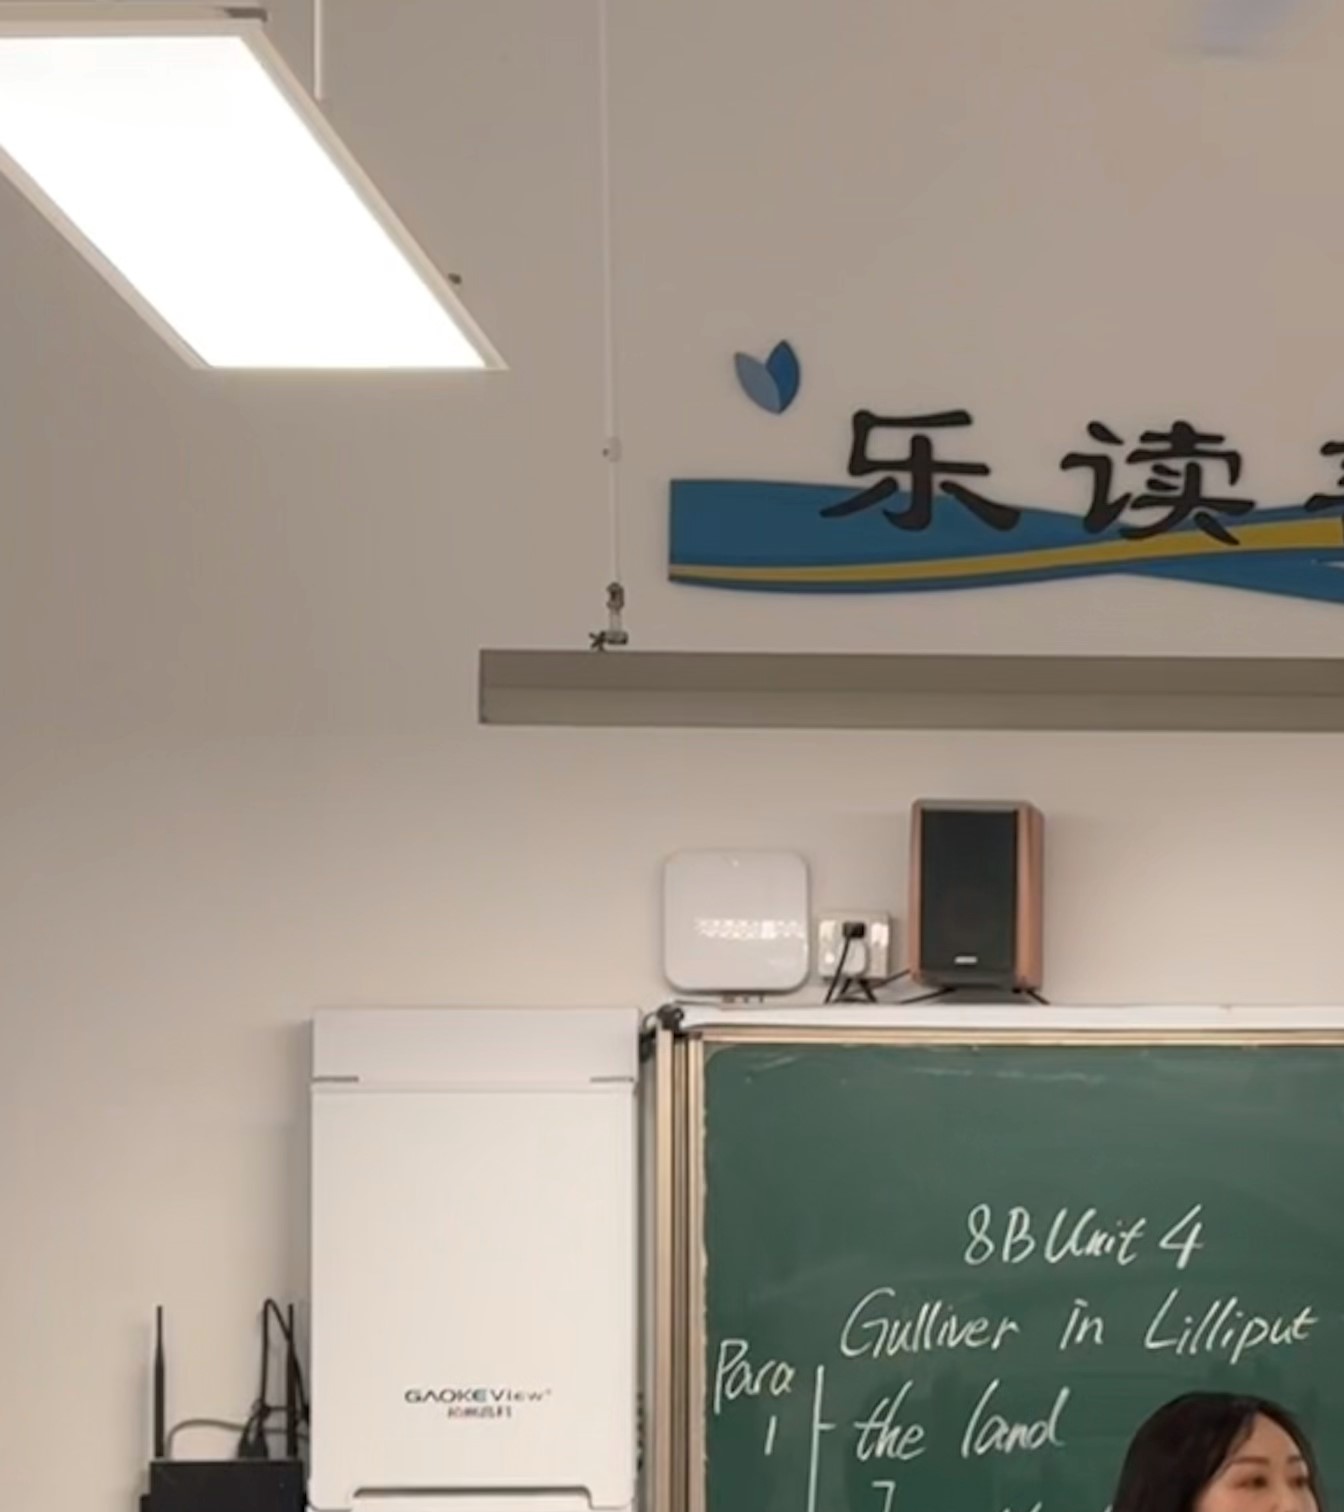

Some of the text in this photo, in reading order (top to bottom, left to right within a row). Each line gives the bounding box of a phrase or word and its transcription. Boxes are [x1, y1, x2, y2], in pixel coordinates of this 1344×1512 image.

[963, 1203, 1205, 1269] 8B Unit 4
[840, 1287, 1318, 1364] Gulliver in Lilliput
[713, 1338, 794, 1414] Para
[763, 1378, 1071, 1461] 1 the land
